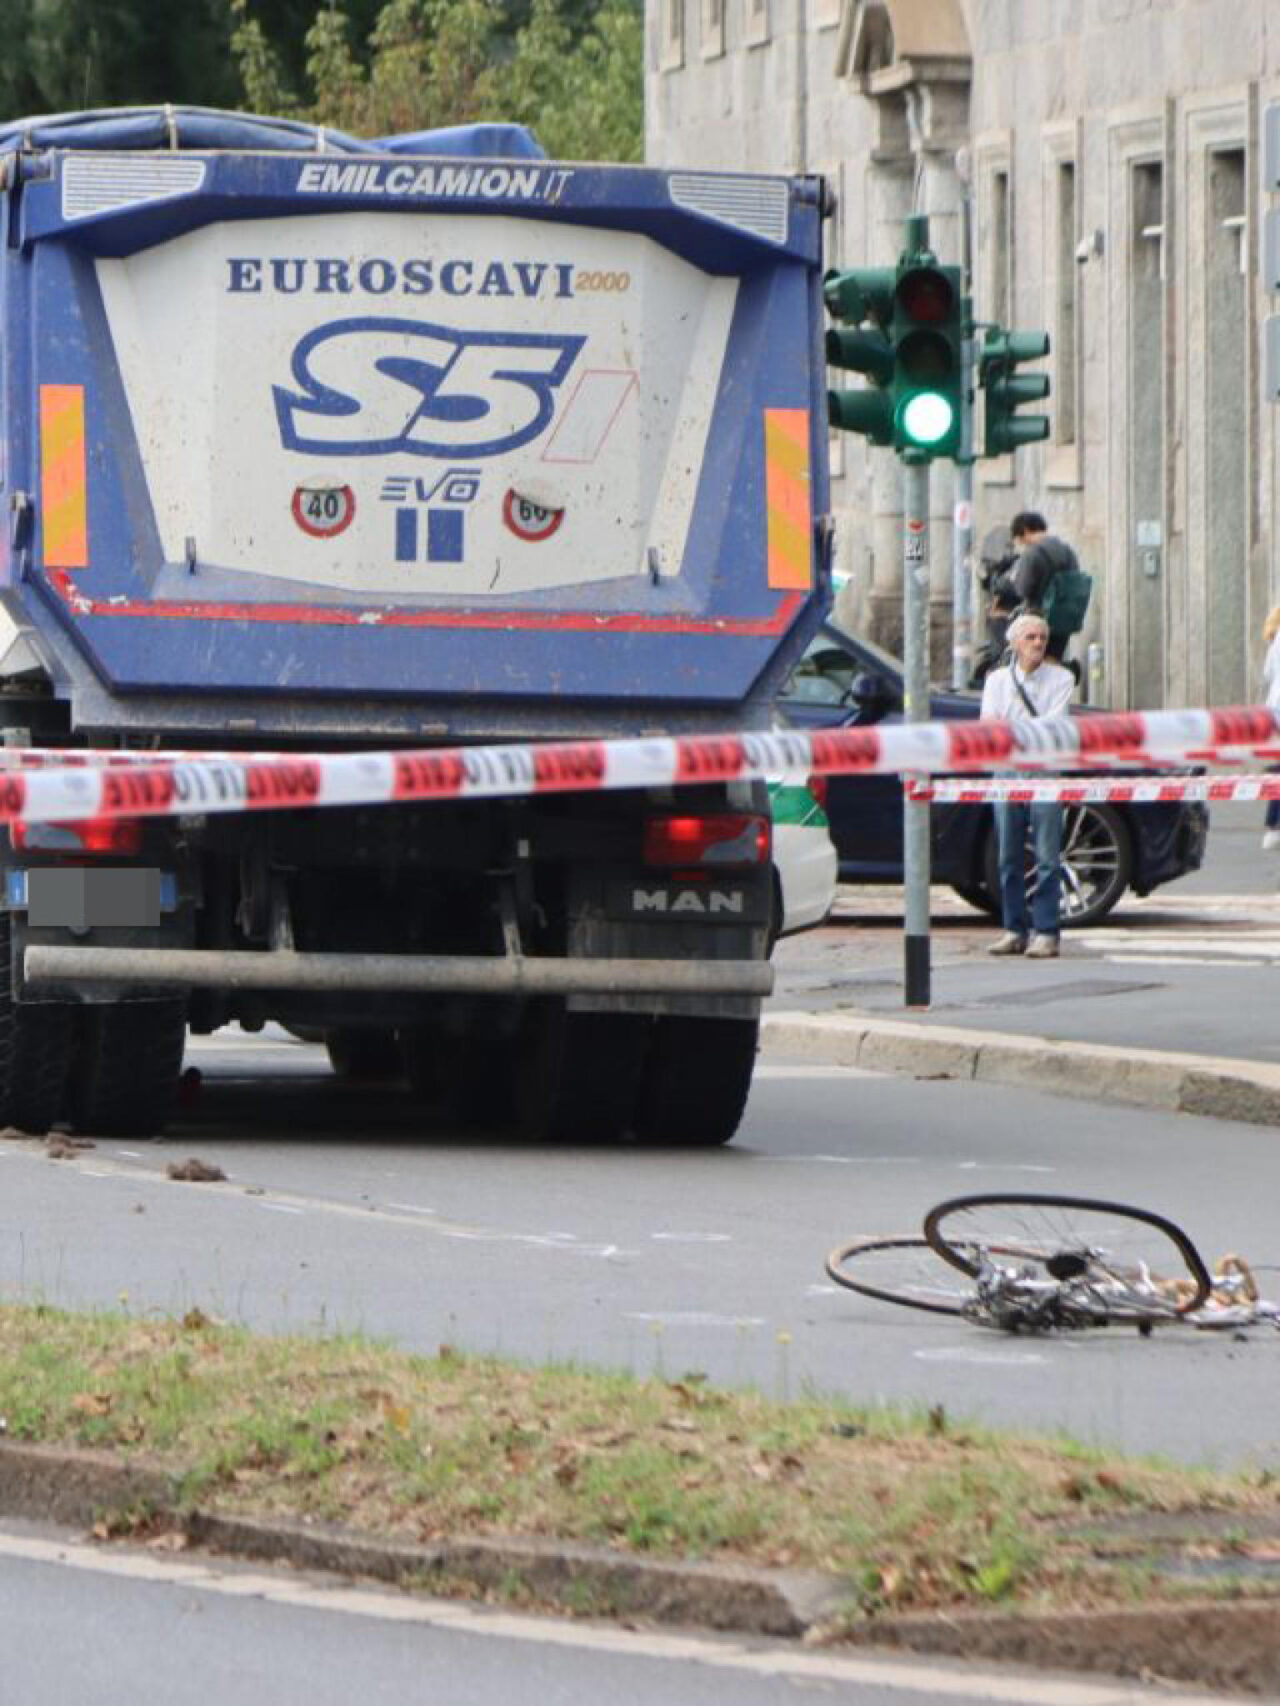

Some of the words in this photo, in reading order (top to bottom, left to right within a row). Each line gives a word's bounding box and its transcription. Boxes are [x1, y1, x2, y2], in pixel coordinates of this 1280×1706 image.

[296, 163, 575, 202] EMILCAMION.IT
[227, 257, 575, 298] EUROSCAVI
[576, 271, 631, 291] 2000
[379, 468, 482, 502] EVO
[307, 493, 339, 519] 40
[633, 889, 743, 912] MAN
